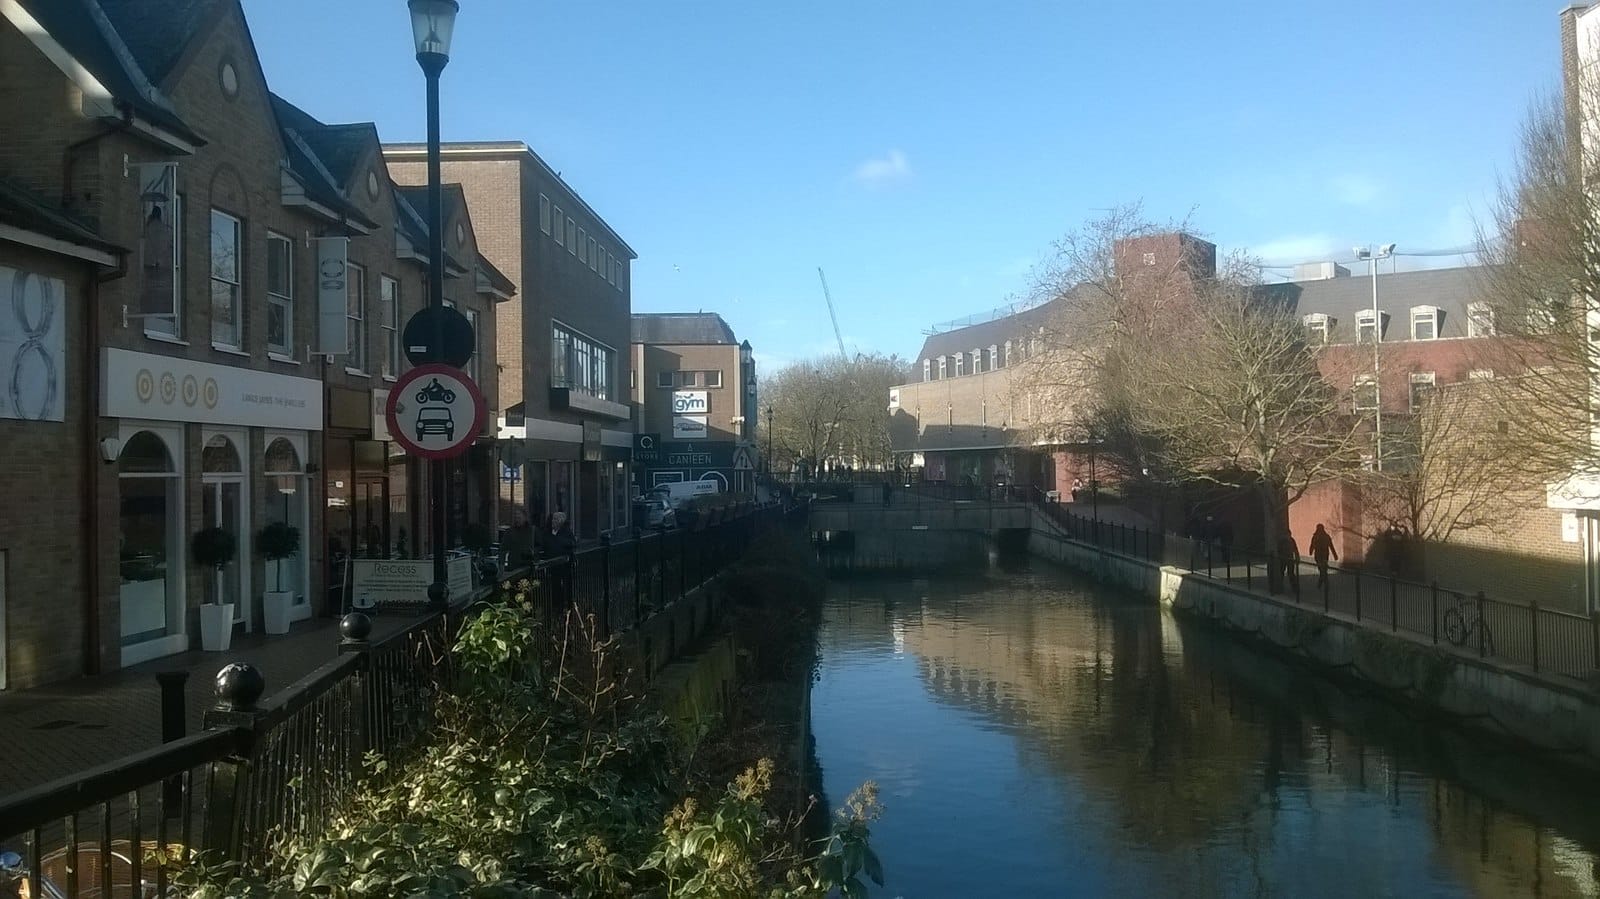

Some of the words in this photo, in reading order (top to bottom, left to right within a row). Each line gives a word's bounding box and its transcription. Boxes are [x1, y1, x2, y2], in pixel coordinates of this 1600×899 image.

[675, 399, 704, 411] gym
[668, 453, 712, 465] CANTEEN
[375, 563, 418, 574] Recess
